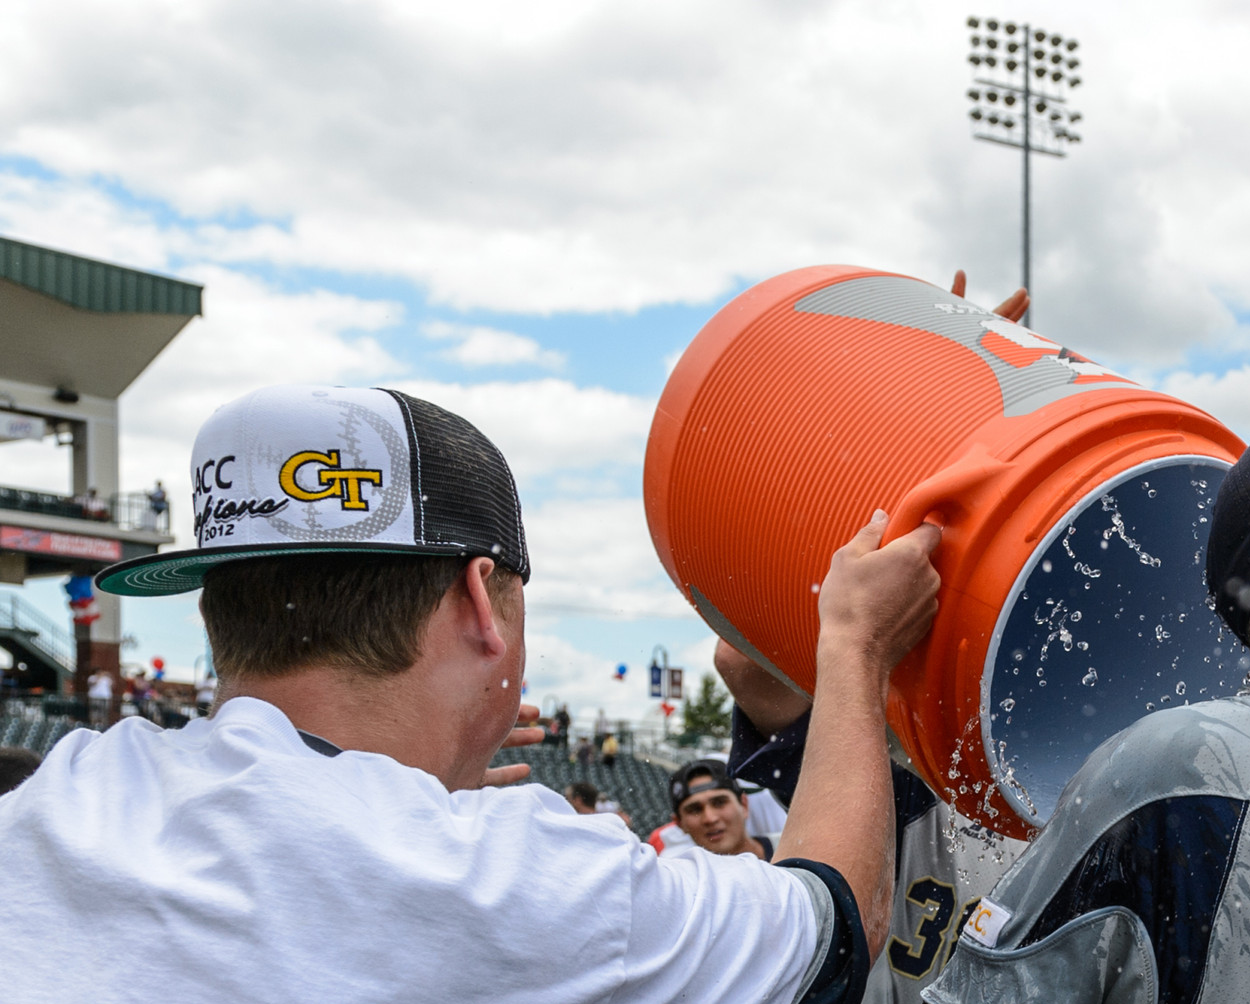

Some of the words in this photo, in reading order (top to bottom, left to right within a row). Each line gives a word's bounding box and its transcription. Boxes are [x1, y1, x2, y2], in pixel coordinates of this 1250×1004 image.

[195, 455, 236, 496] ACC
[278, 449, 383, 511] GT
[204, 524, 234, 541] 2012
